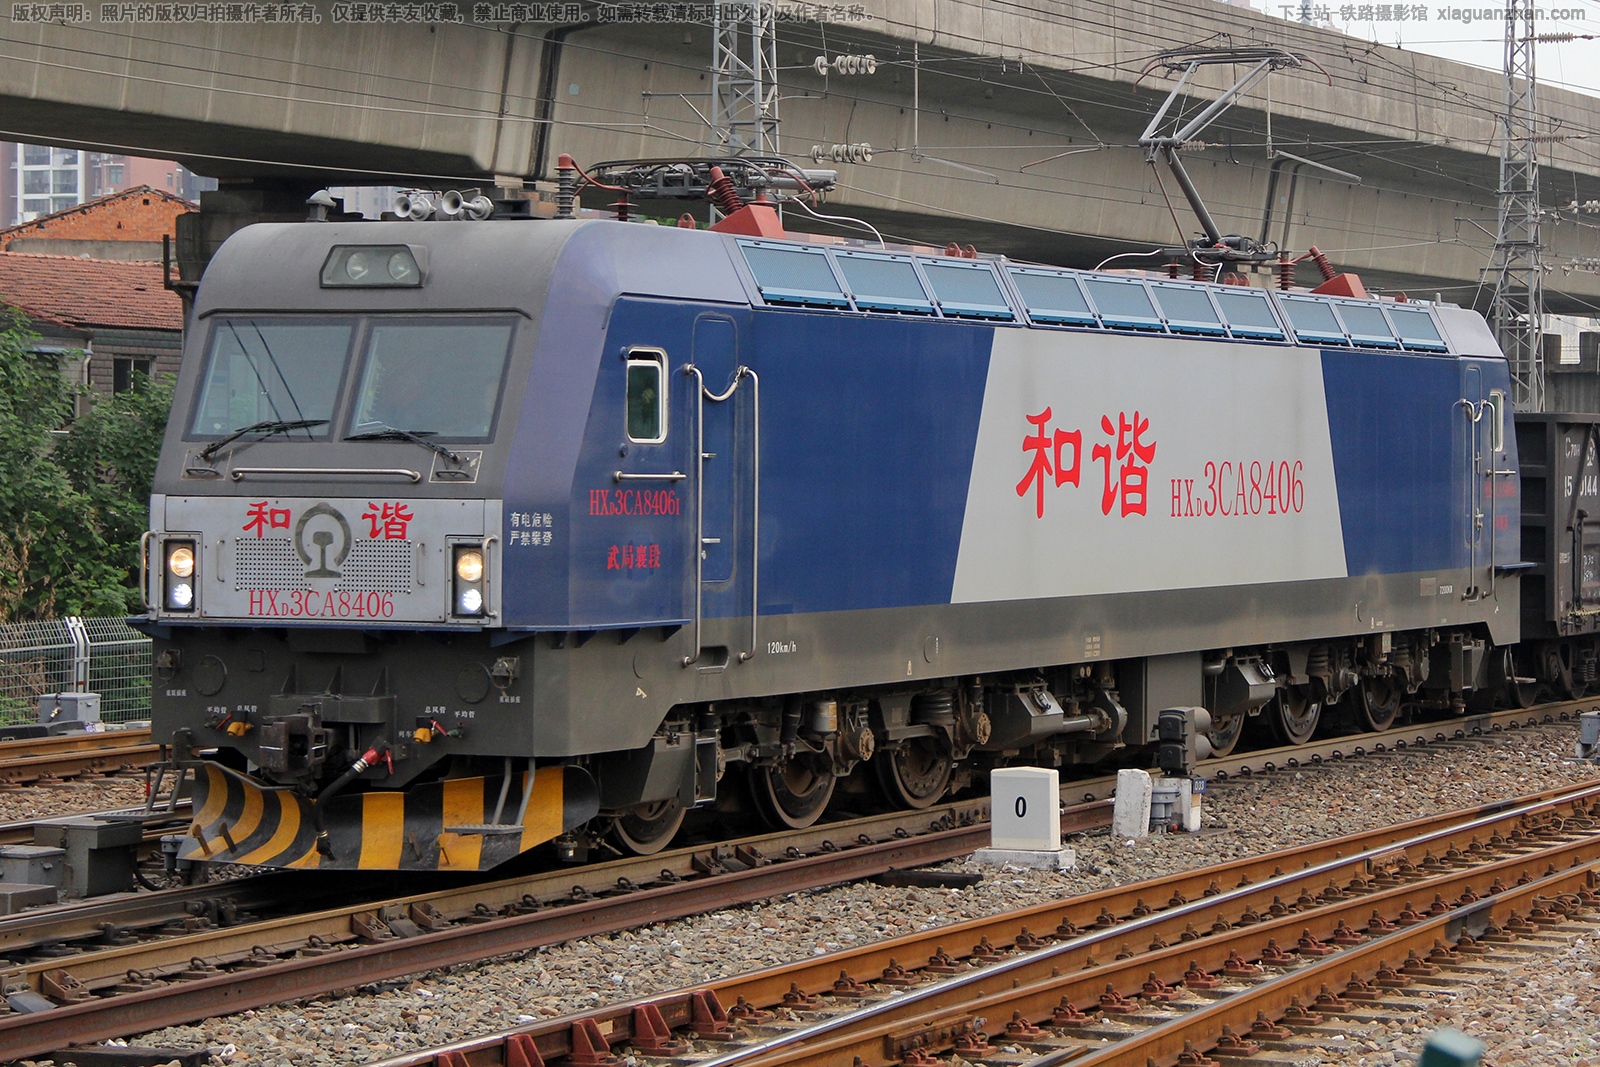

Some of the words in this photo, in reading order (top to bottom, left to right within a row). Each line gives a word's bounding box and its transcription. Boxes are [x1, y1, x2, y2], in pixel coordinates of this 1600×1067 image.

[1015, 406, 1157, 519] 和谐
[242, 501, 291, 538] 和
[361, 502, 414, 540] 谐
[510, 511, 553, 528] 有电危险
[509, 530, 553, 547] 严禁攀登
[606, 544, 661, 570] 武局襄段
[767, 641, 797, 654] 120km/h
[398, 729, 417, 738] 列车
[1015, 796, 1027, 818] 0
